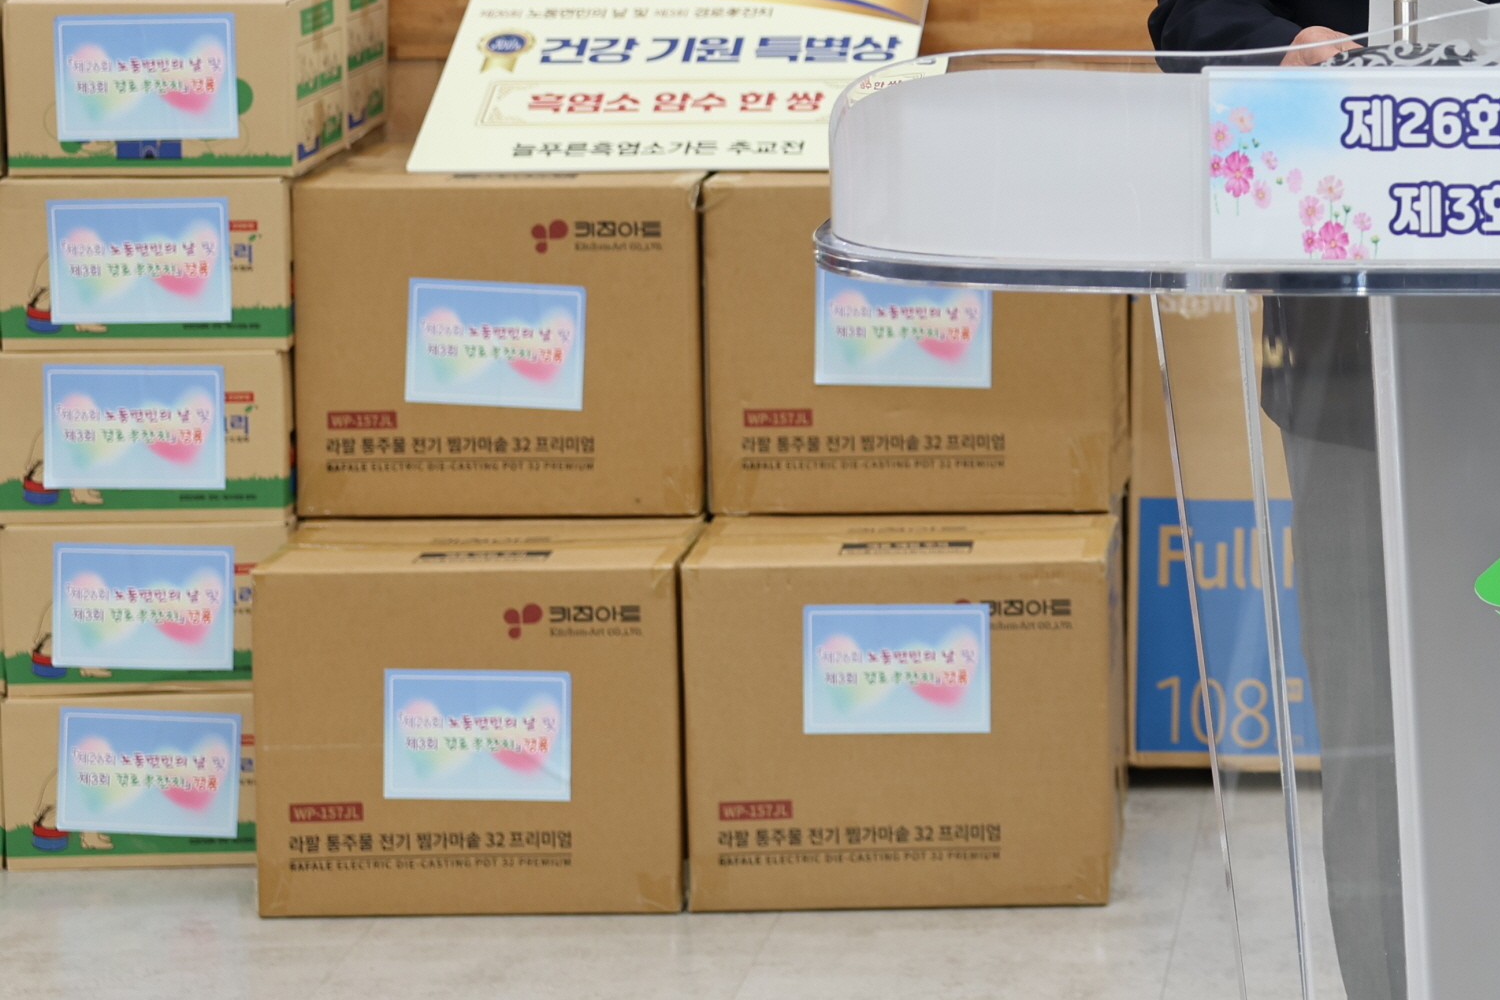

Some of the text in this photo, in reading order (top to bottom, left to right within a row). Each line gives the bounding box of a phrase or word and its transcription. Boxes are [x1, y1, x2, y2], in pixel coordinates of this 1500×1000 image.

[539, 34, 641, 64] 건강
[645, 34, 744, 64] 기원
[752, 34, 903, 64] 특별상
[526, 90, 826, 114] 흑염소 암수 한 쌍
[511, 138, 807, 158] 늘푸른흑염소가든 추교전
[411, 436, 442, 454] 전기
[512, 436, 531, 452] 32
[535, 435, 595, 454] 프리미엄
[825, 435, 855, 452] 전기
[924, 434, 942, 450] 32
[946, 433, 1005, 451] 프리미엄
[379, 832, 411, 851] 전기
[485, 832, 505, 848] 32
[509, 830, 572, 849] 프리미엄
[808, 828, 840, 846] 전기
[914, 826, 934, 841] 32
[938, 824, 1001, 843] 프리미엄
